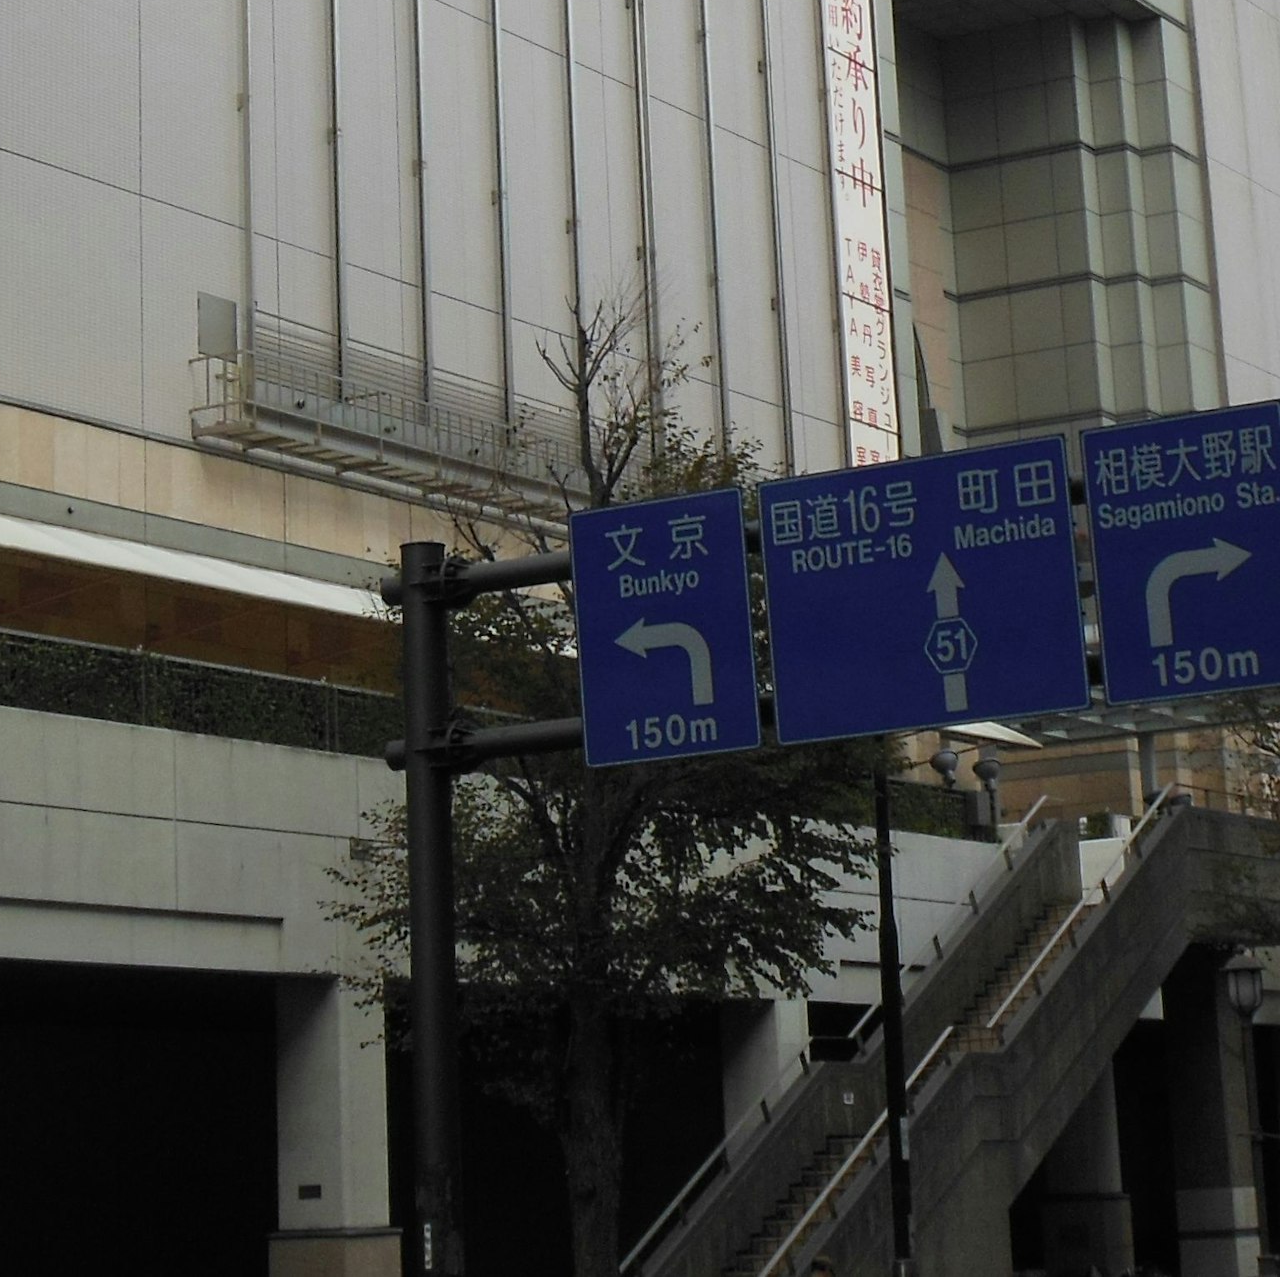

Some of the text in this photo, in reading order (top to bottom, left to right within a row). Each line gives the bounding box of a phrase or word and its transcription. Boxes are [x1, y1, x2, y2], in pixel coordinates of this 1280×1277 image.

[1095, 425, 1277, 496] 相模大野駅
[957, 460, 1056, 513] 町田
[1098, 482, 1280, 529] Sagamiono Sta.
[771, 481, 917, 545] 国道16号
[954, 514, 1056, 550] Machida
[605, 514, 709, 571] 文京
[792, 534, 912, 573] ROUTE-16
[620, 570, 699, 598] Bunkyo
[936, 628, 968, 662] 51
[1152, 647, 1260, 687] 150m
[626, 714, 718, 750] 150m
